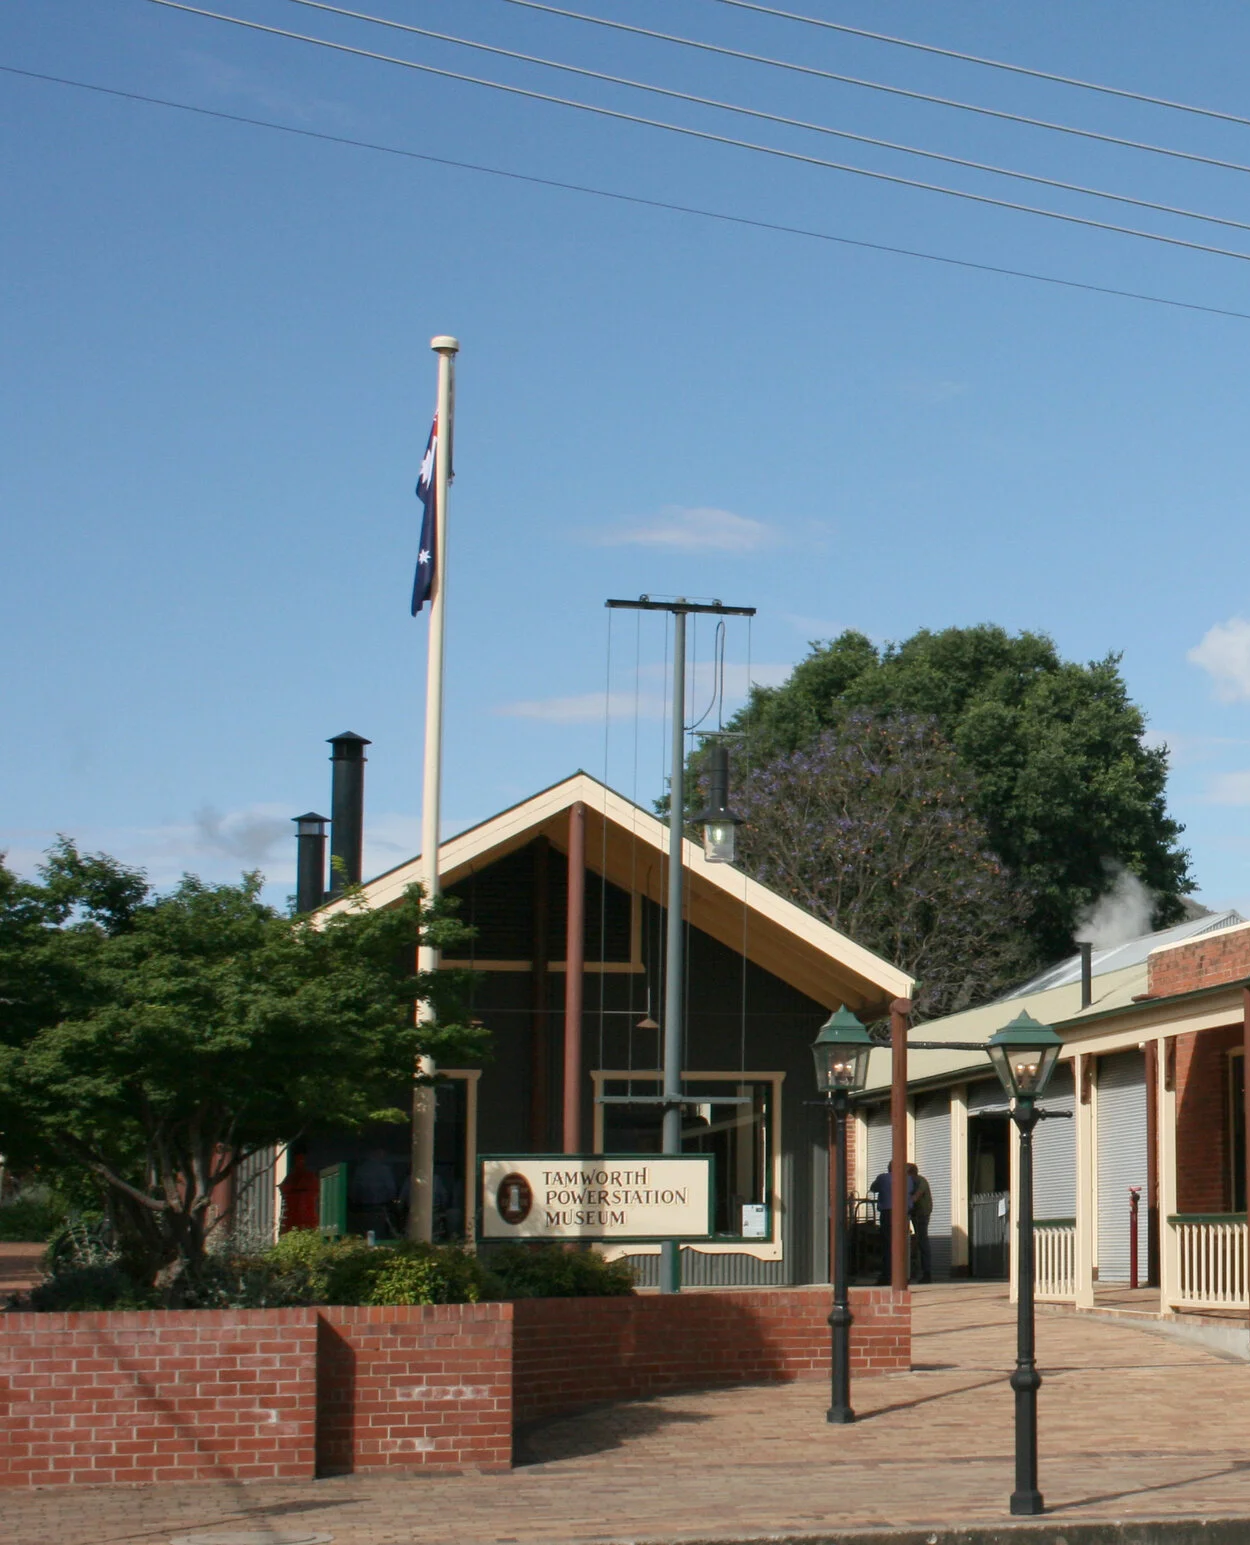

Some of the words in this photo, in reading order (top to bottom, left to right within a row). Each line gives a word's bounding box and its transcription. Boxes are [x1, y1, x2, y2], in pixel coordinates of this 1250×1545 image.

[542, 1168, 647, 1187] TAMWORTH
[546, 1188, 686, 1206] POWERSTATION
[546, 1210, 625, 1226] MUSEUM
